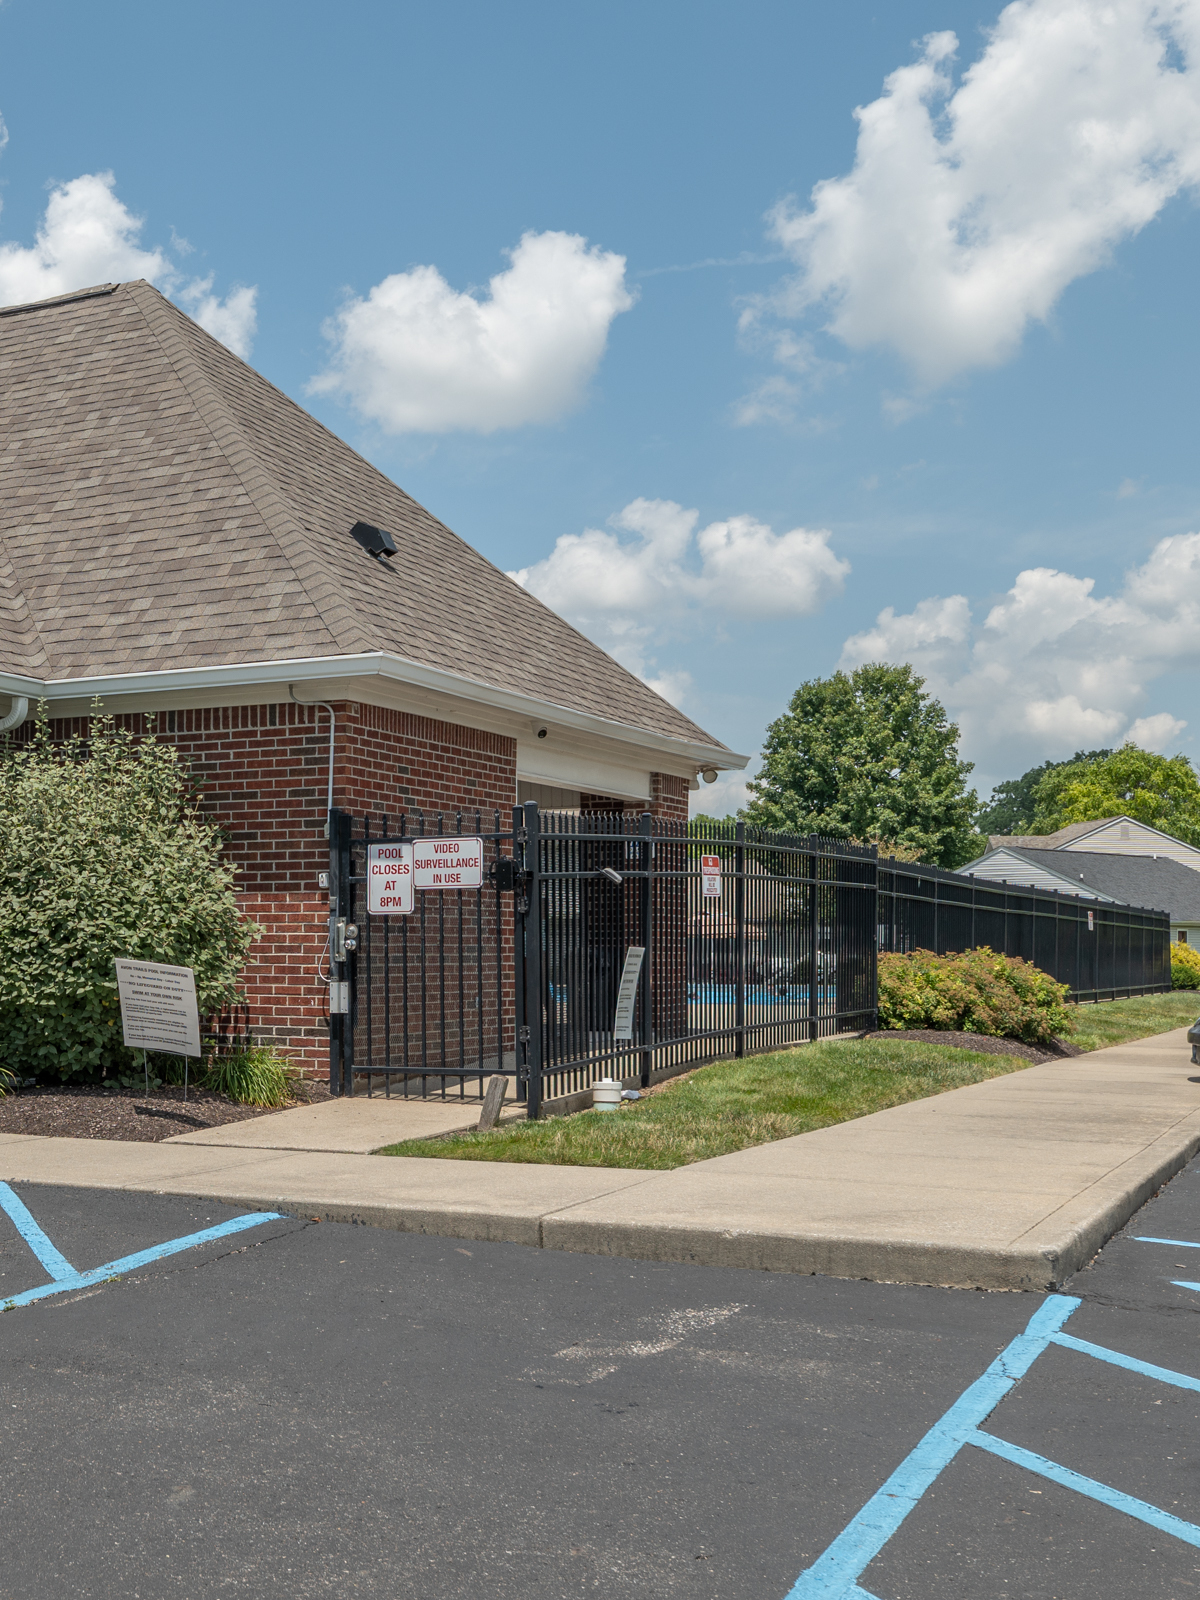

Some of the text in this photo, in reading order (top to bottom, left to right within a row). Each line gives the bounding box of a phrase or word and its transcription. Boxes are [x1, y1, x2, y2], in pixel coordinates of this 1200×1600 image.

[378, 848, 404, 859] POOL
[433, 843, 460, 854] VIDEO
[414, 857, 480, 870] SURVEILLANCE
[372, 864, 410, 875] CLOSES
[433, 873, 462, 884] IN USE
[384, 881, 397, 891] AT
[380, 896, 402, 907] 8PM
